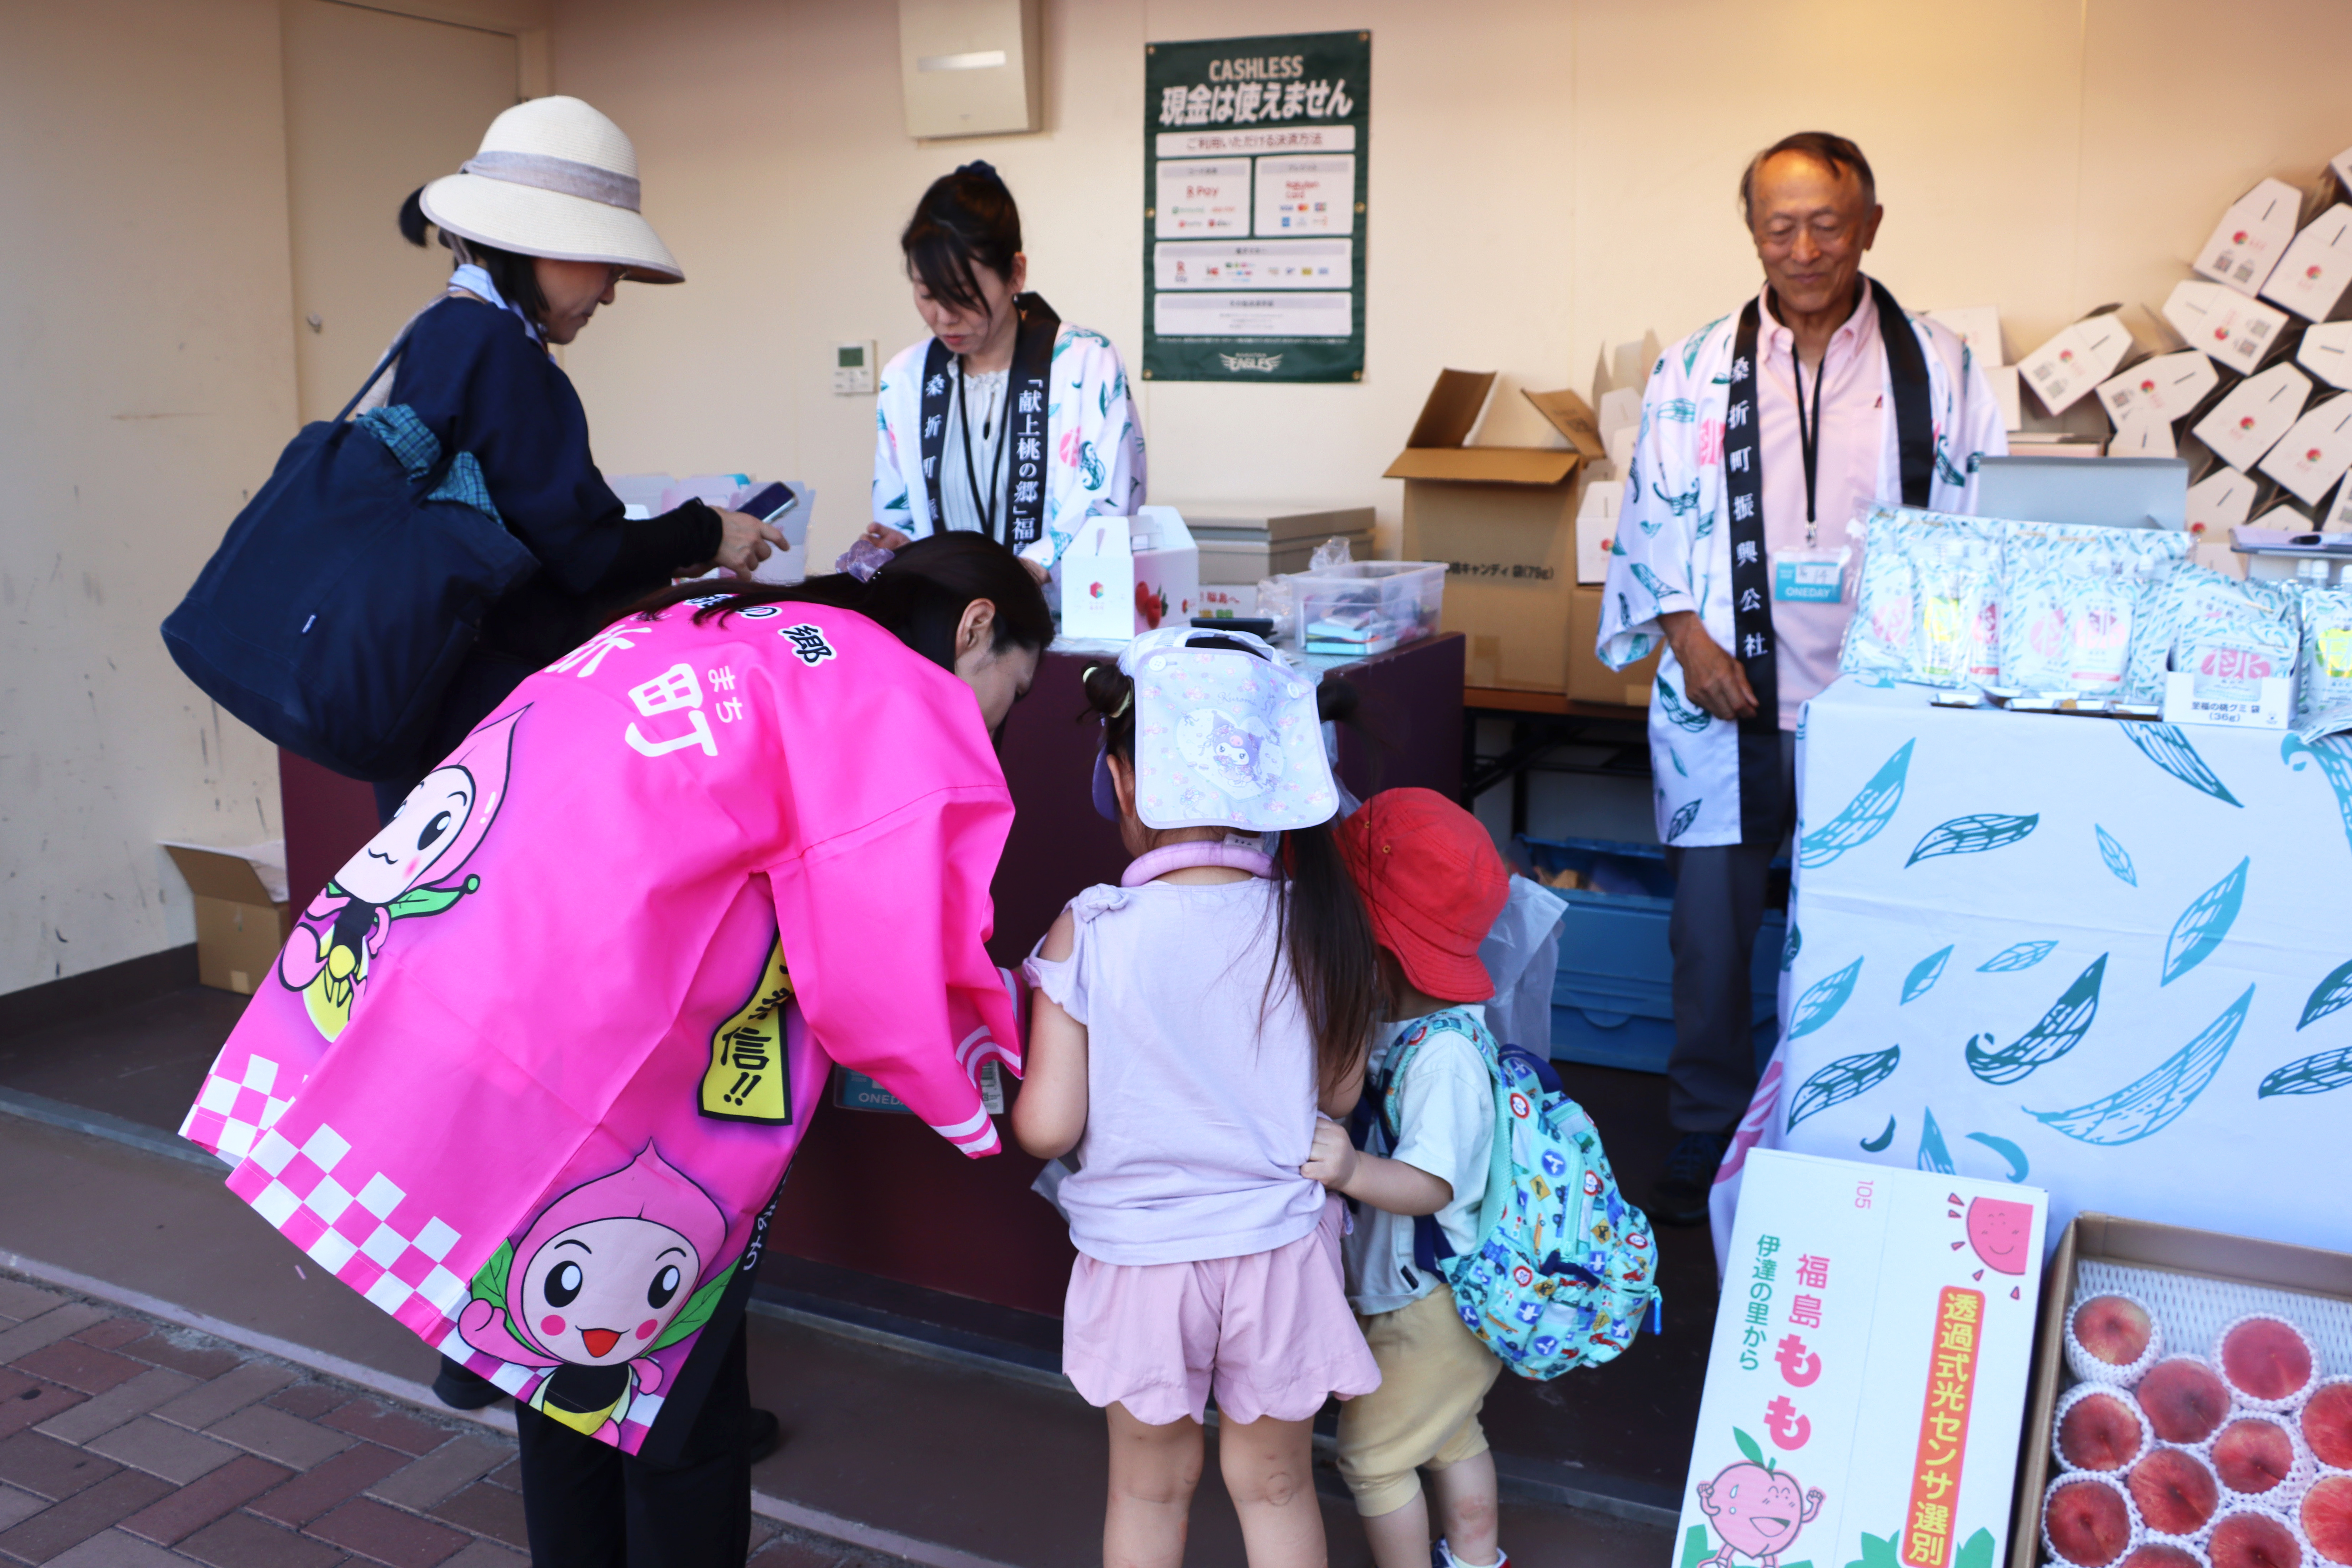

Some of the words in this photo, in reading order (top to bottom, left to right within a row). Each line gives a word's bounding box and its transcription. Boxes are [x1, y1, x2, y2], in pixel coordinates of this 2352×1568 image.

[1208, 55, 1304, 82] CASHLESS
[1159, 78, 1353, 126] 現金は使えません
[1728, 356, 1768, 659] 桑折町振興公社
[1785, 587, 1831, 598] ONEDAY
[2209, 712, 2240, 722] (36g)
[1854, 1180, 1874, 1209] 105
[1738, 1234, 1781, 1371] 伊達の里から
[1908, 1292, 1978, 1566] 透過式光センサ選別
